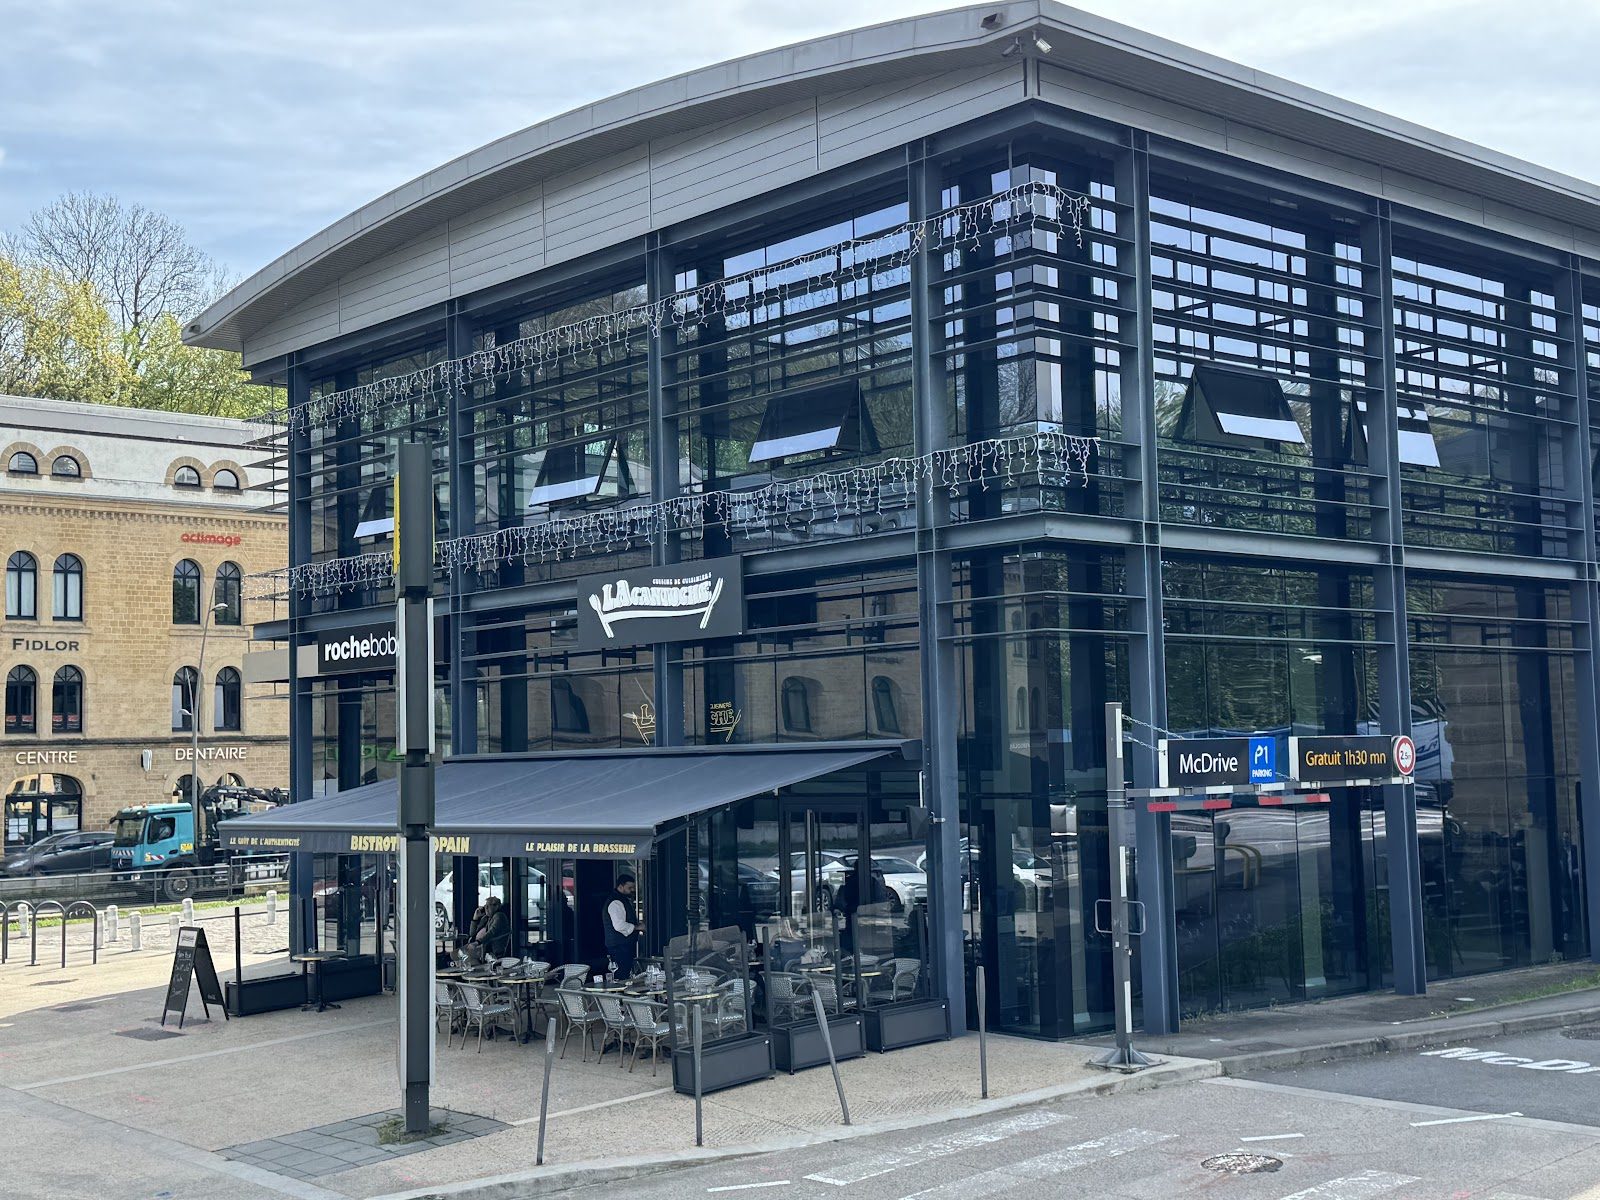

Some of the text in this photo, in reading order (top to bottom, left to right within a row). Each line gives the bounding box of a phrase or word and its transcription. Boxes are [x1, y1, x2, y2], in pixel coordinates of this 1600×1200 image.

[181, 531, 242, 547] actimage
[12, 638, 80, 651] FIDLOR
[324, 630, 398, 661] rochebob
[16, 750, 78, 765] CENTRE
[175, 747, 248, 761] DENTAIRE
[1305, 749, 1387, 767] Gratuit 1h30 mn
[1179, 752, 1239, 774] McDrive
[1251, 768, 1273, 778] PARKING
[350, 835, 471, 853] BISTROT OPAIN
[525, 842, 637, 854] LE PLAISIR DE LA BRASSERIE
